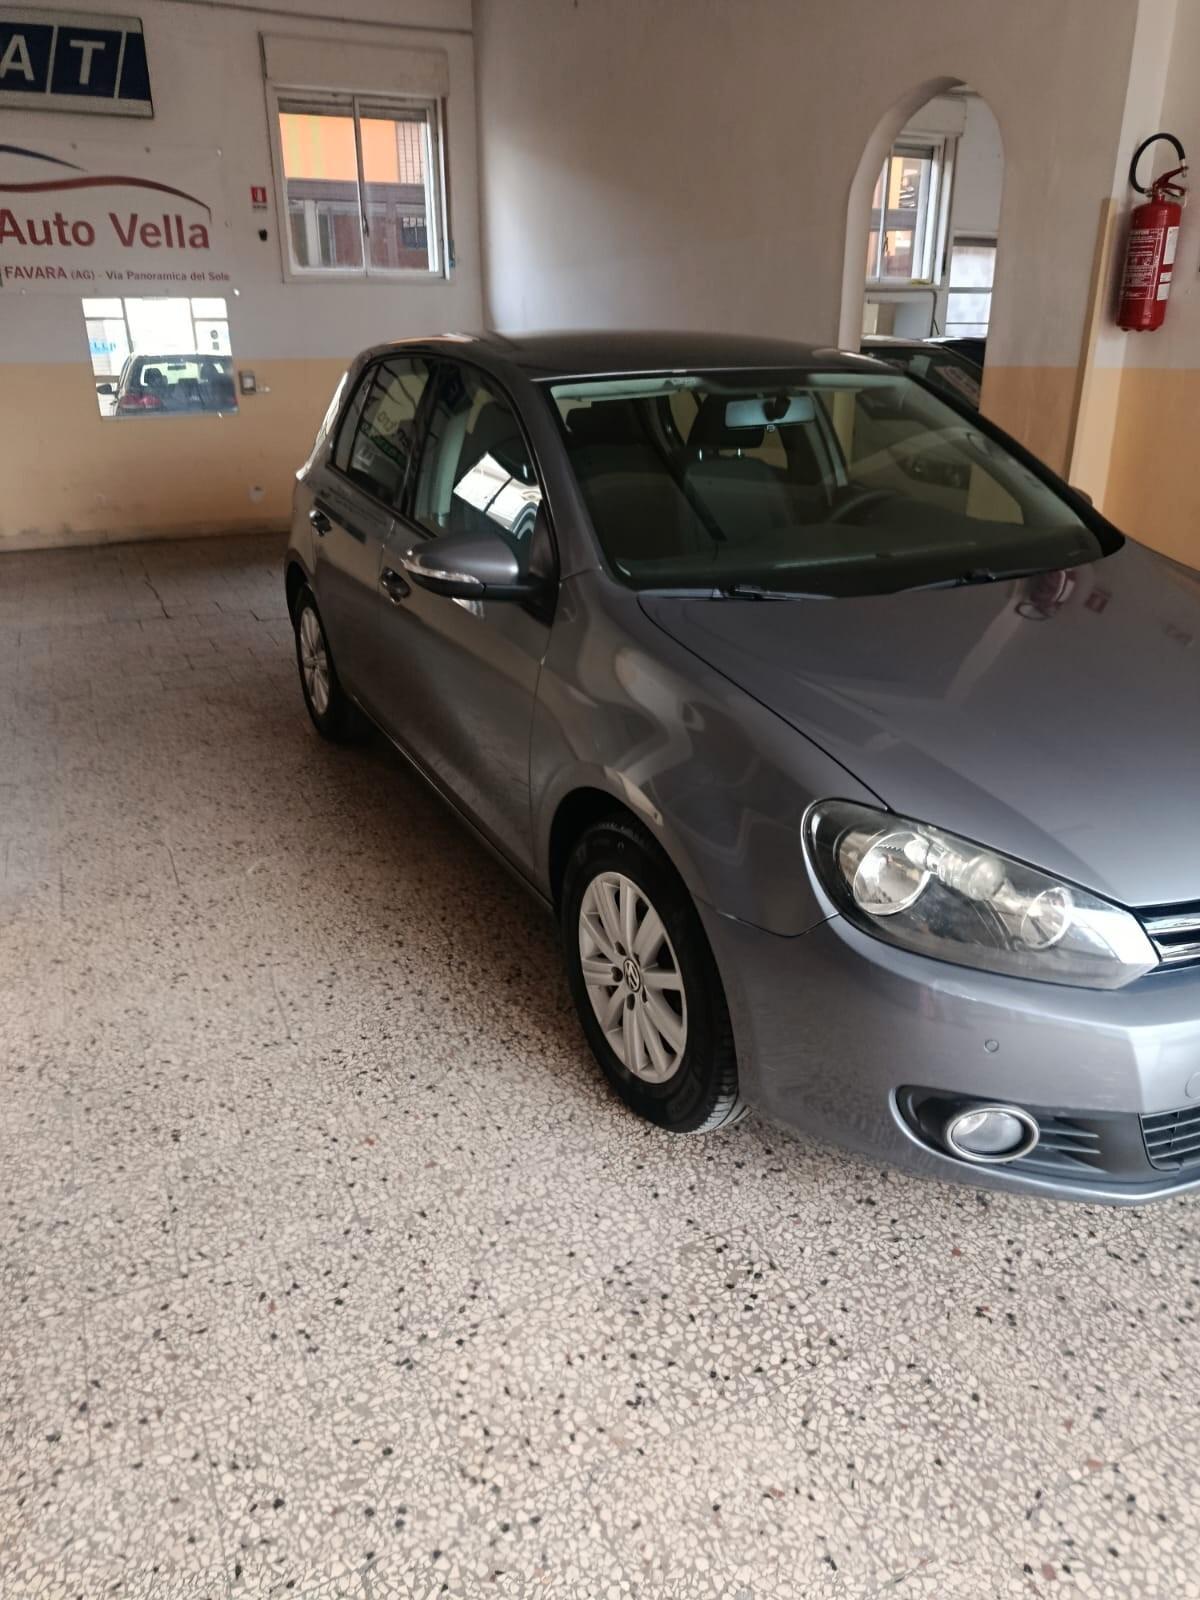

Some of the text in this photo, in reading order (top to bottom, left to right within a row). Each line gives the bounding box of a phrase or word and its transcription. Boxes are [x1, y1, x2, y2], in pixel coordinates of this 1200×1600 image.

[0, 209, 210, 249] Auto Vella
[4, 266, 67, 280] FAVARA
[71, 270, 95, 281] (AG)
[106, 271, 123, 281] Via
[127, 271, 187, 282] Panoramica
[190, 271, 205, 281] del
